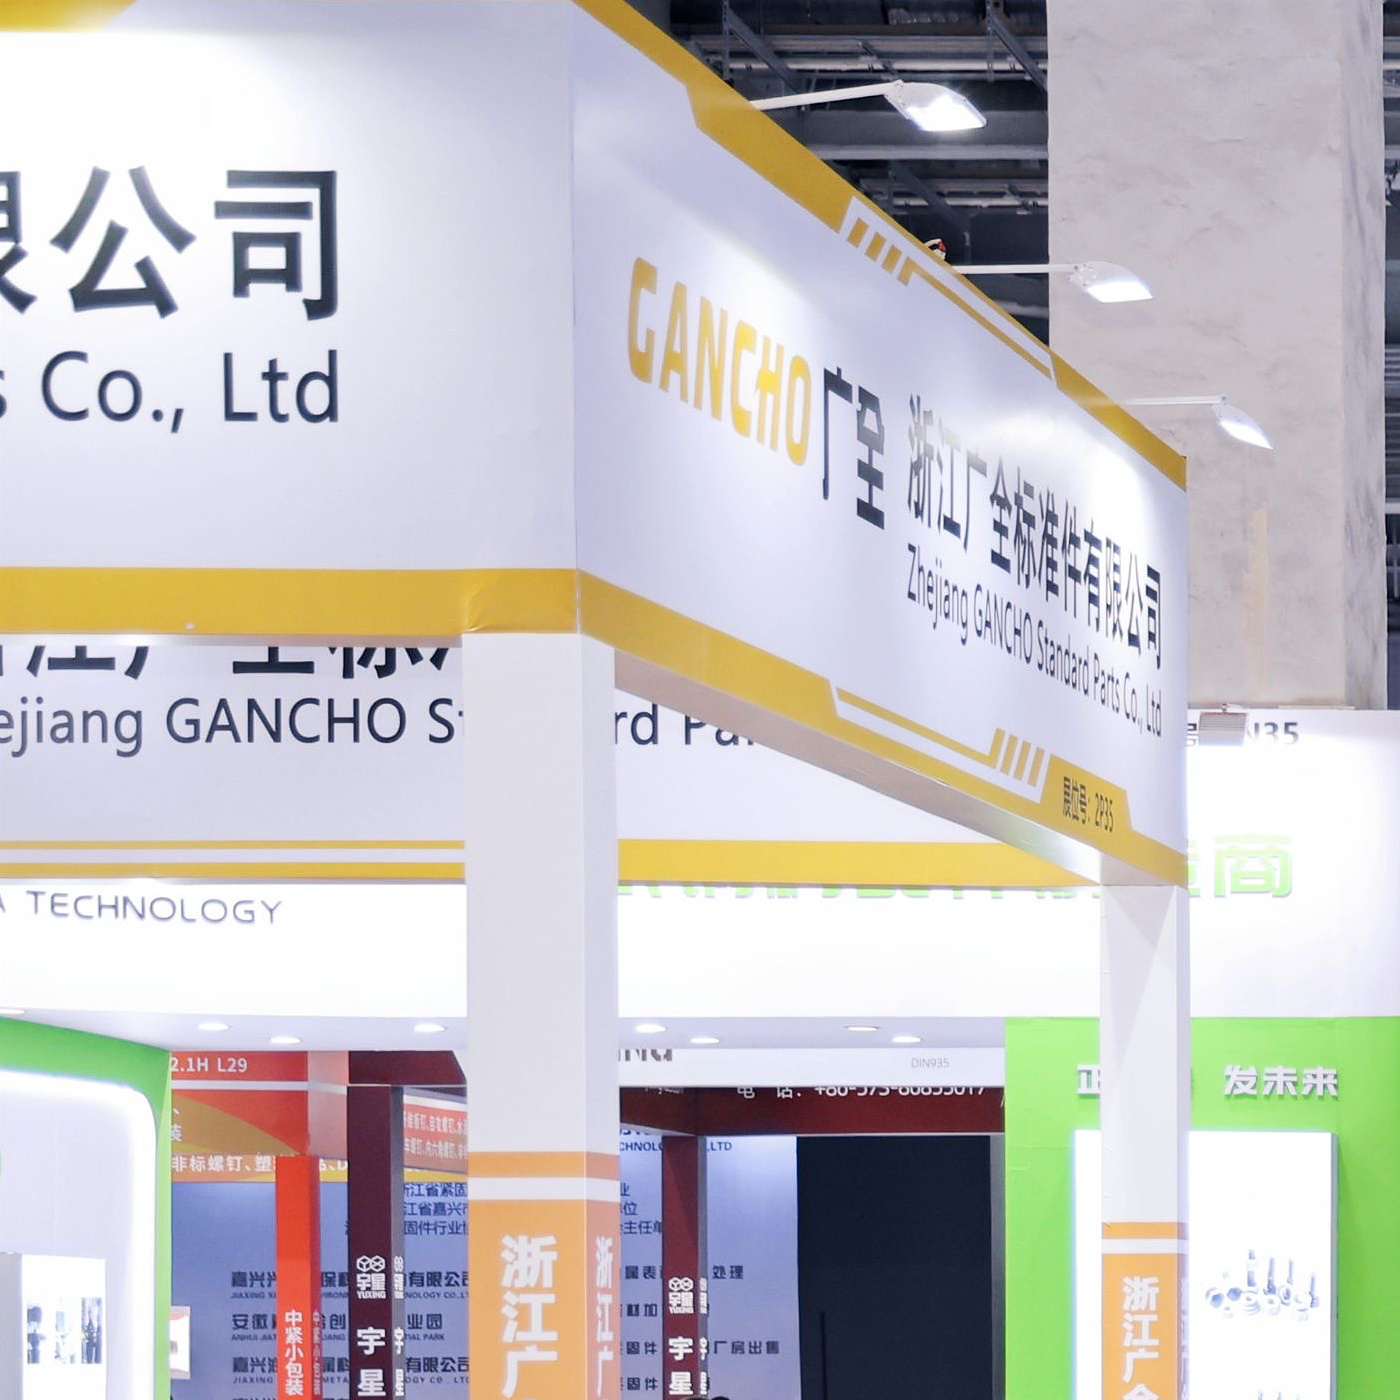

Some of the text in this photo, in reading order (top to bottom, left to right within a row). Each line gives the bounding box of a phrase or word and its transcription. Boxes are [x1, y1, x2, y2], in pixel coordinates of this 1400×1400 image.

[0, 165, 340, 320] 公司
[41, 349, 340, 433] Co., Ltd
[628, 257, 812, 467] GANCHO
[907, 393, 1163, 669] 浙江广全标准件有限公司
[907, 543, 969, 646] Zhejiang
[974, 582, 1034, 667] GANCHO
[1037, 619, 1091, 695] Standard
[1094, 652, 1123, 711] Parts
[1146, 689, 1163, 737] Ltd
[166, 698, 408, 746] GANCHO
[26, 890, 282, 926] TECHNOLOGY
[217, 1057, 248, 1073] L29
[910, 1057, 950, 1069] DIN935
[1223, 1063, 1339, 1098] 发未来
